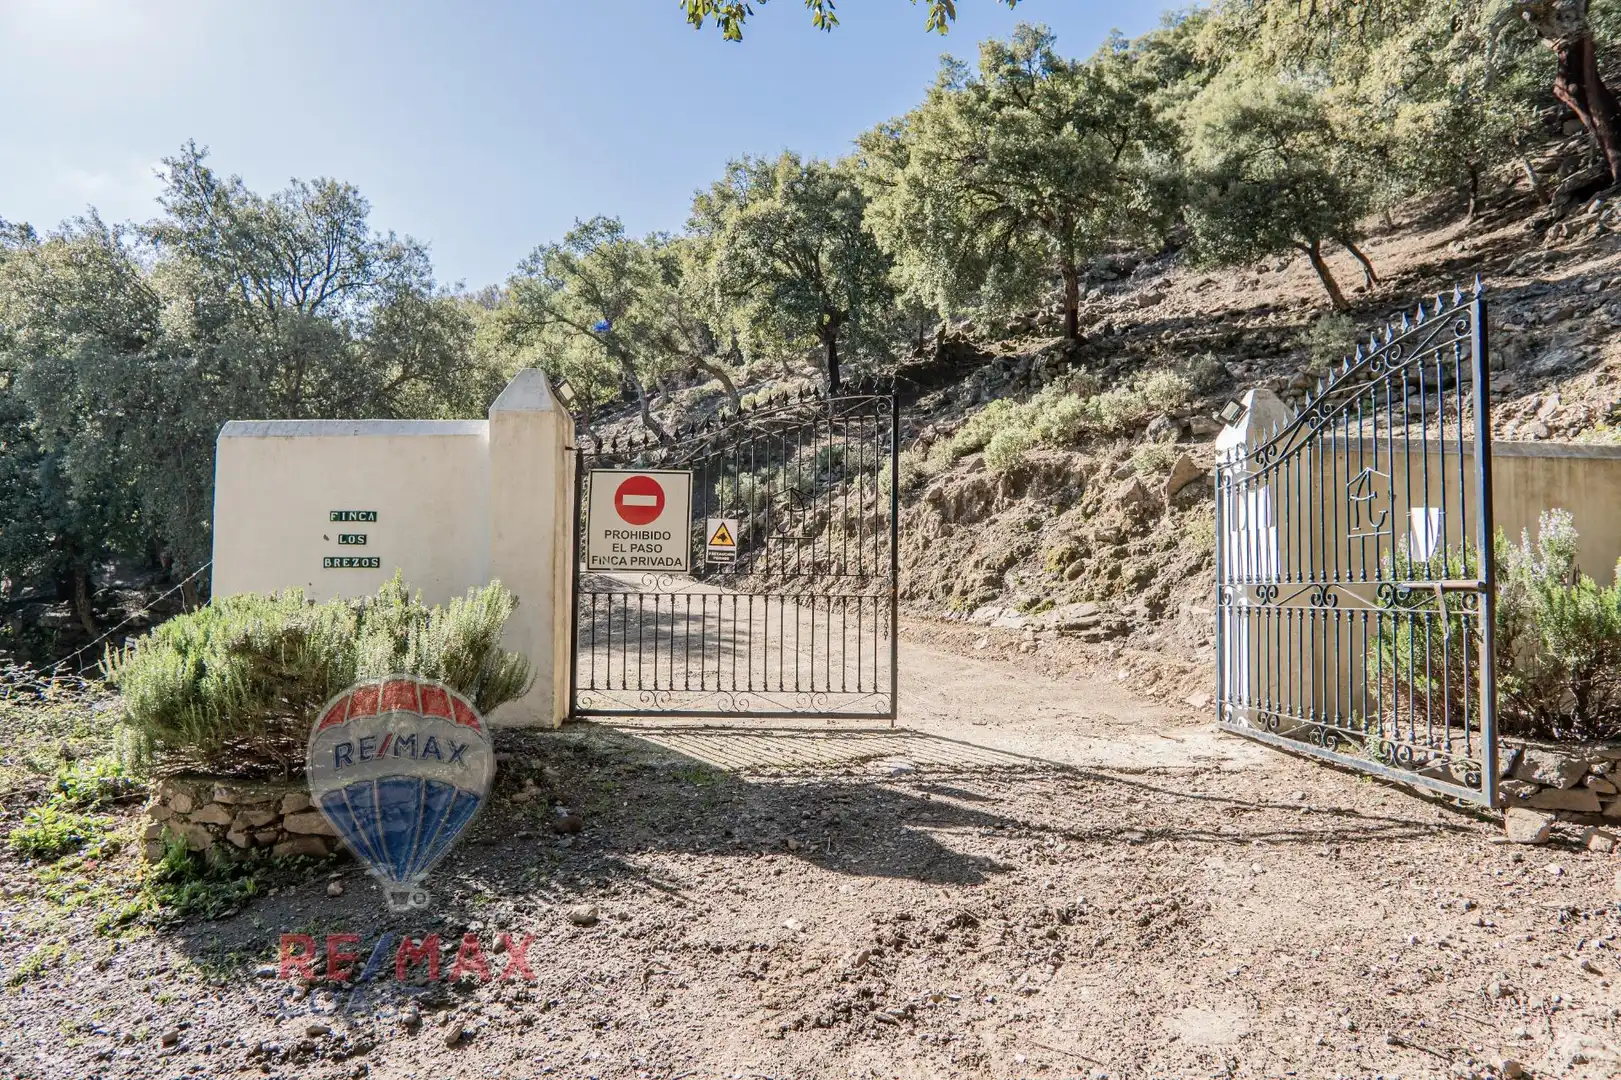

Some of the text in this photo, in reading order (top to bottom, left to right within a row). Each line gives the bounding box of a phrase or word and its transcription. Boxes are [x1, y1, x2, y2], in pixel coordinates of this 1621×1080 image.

[330, 511, 376, 521] FINCA
[339, 534, 366, 544] LOS
[604, 529, 671, 541] PROHIBIDO
[612, 543, 663, 554] EL PASO
[324, 557, 380, 568] BREZOS
[591, 555, 683, 567] FINCA PRIVADA
